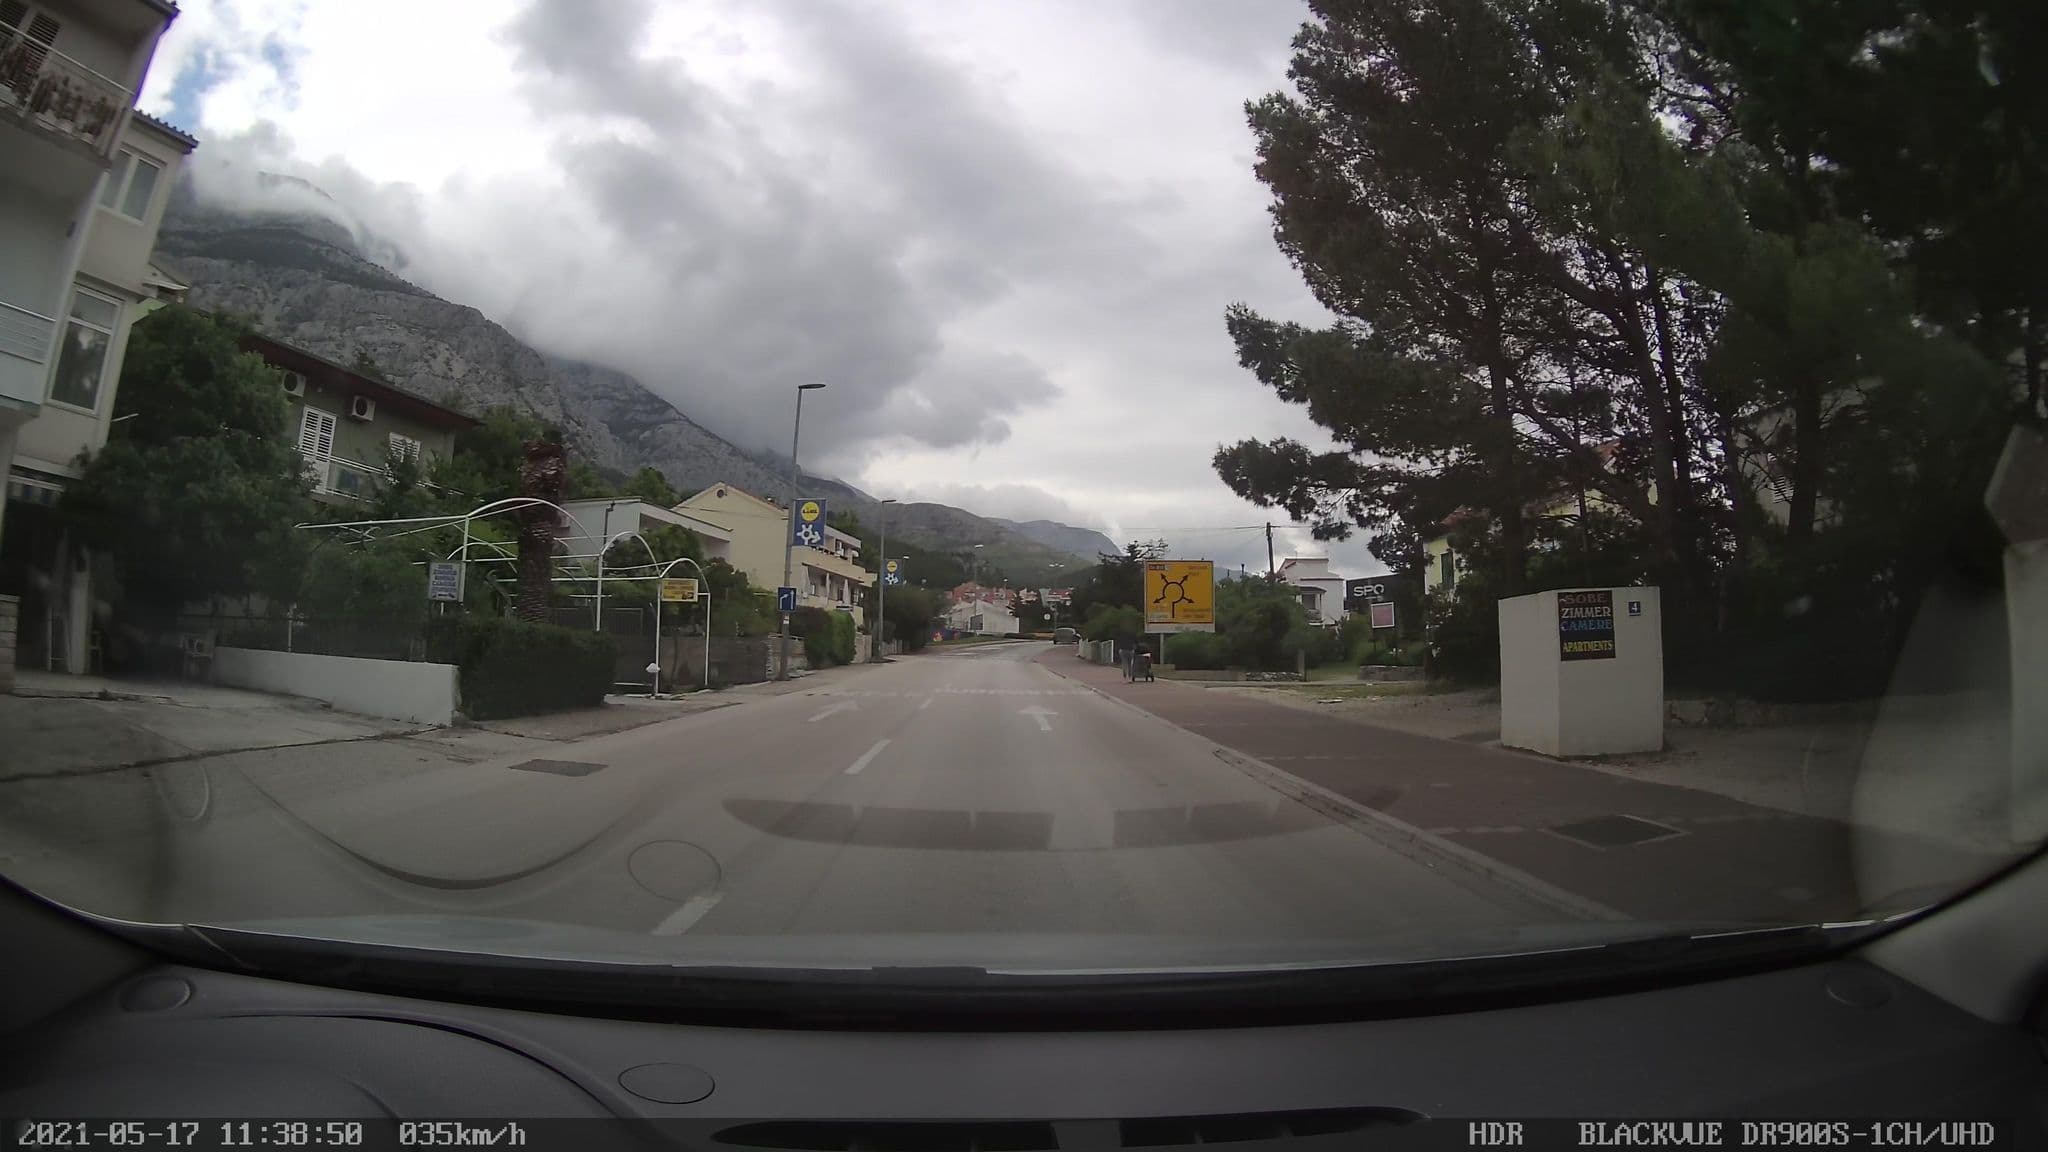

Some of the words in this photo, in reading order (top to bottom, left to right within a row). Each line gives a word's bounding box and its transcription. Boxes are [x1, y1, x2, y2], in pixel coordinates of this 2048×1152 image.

[1564, 593, 1606, 604] SOBE
[1561, 606, 1611, 618] ZIMMER
[1631, 602, 1638, 613] 4
[1561, 619, 1612, 631] CAMERE
[1562, 640, 1613, 652] APARTMENTS
